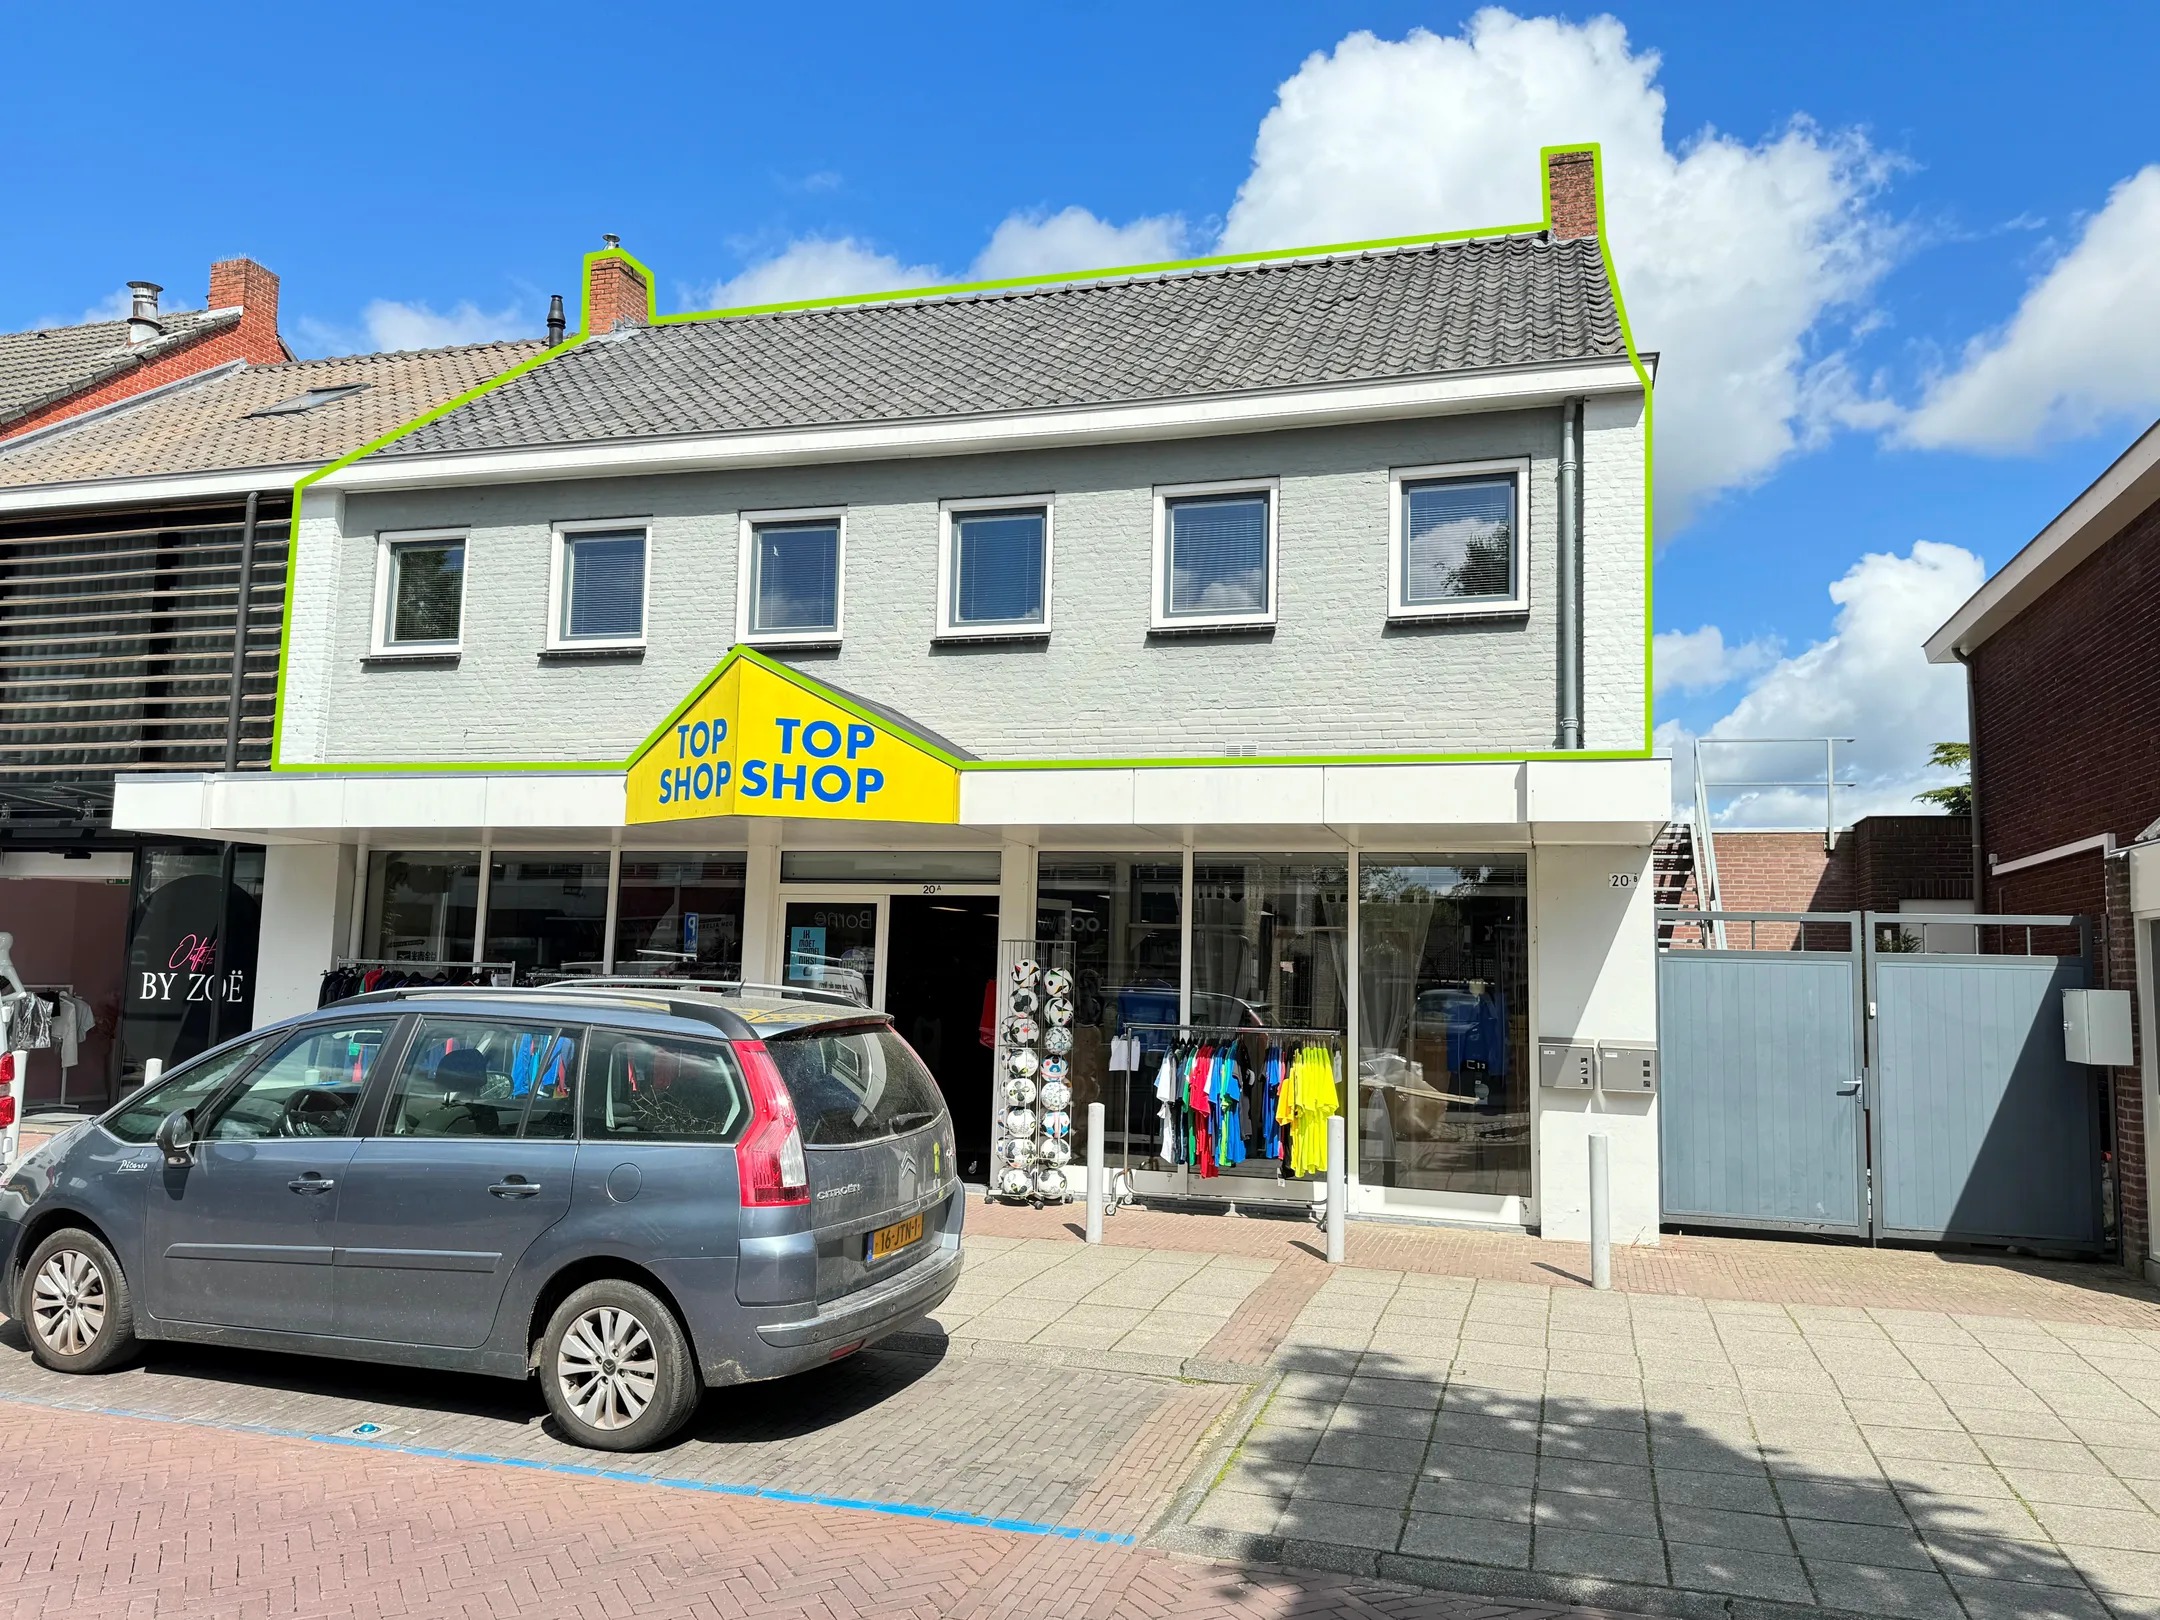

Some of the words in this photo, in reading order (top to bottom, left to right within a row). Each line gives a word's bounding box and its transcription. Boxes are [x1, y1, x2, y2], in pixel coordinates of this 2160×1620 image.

[677, 718, 728, 759] TOP
[775, 717, 875, 759] TOP
[658, 760, 732, 804] SHOP
[740, 759, 885, 803] SHOP
[1611, 874, 1629, 887] 20
[139, 972, 179, 1001] BY
[116, 1159, 148, 1174] Picasso
[880, 1217, 919, 1252] 16-JTN-1
